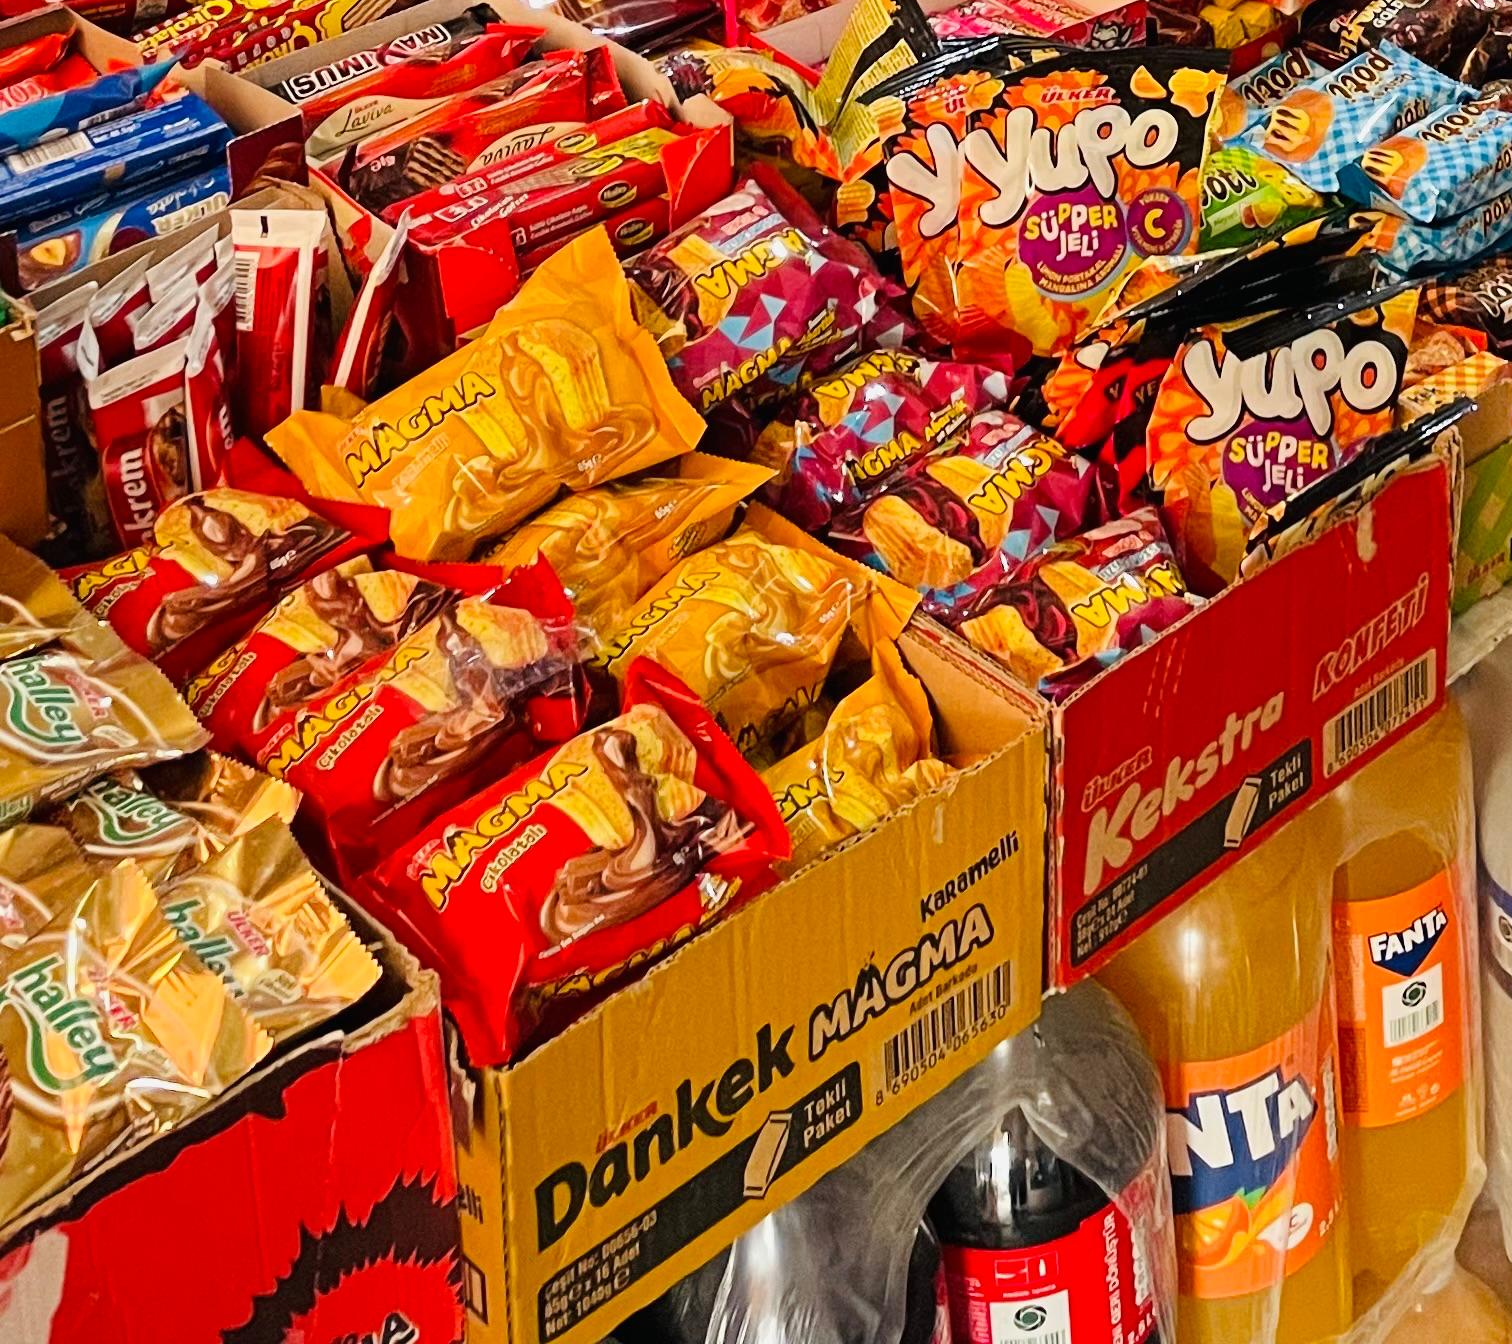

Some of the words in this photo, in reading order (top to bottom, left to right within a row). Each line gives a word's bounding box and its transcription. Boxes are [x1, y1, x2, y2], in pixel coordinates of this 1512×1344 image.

[1372, 0, 1404, 29] GOLD
[1040, 86, 1114, 105] ÜLKER
[334, 102, 395, 138] Laviva
[1023, 201, 1120, 242] SÜPPER
[1144, 208, 1167, 239] C
[1181, 327, 1398, 444] yupo
[344, 370, 497, 489] MAGMA
[1229, 430, 1330, 471] SÜPPER
[6, 654, 86, 746] halley
[1081, 746, 1153, 811] ÜLKER
[1268, 751, 1304, 789] Tekli
[1268, 773, 1305, 809] Paket
[1084, 692, 1286, 898] Kekstra
[420, 759, 589, 912] MAGMA
[226, 911, 270, 957] ÜLKER
[1367, 907, 1449, 966] FANTA
[807, 901, 995, 1062] MAGMA
[9, 954, 119, 1083] halley
[803, 1079, 848, 1119] Tekli
[535, 1023, 797, 1254] Dankek
[802, 1103, 853, 1148] Paket
